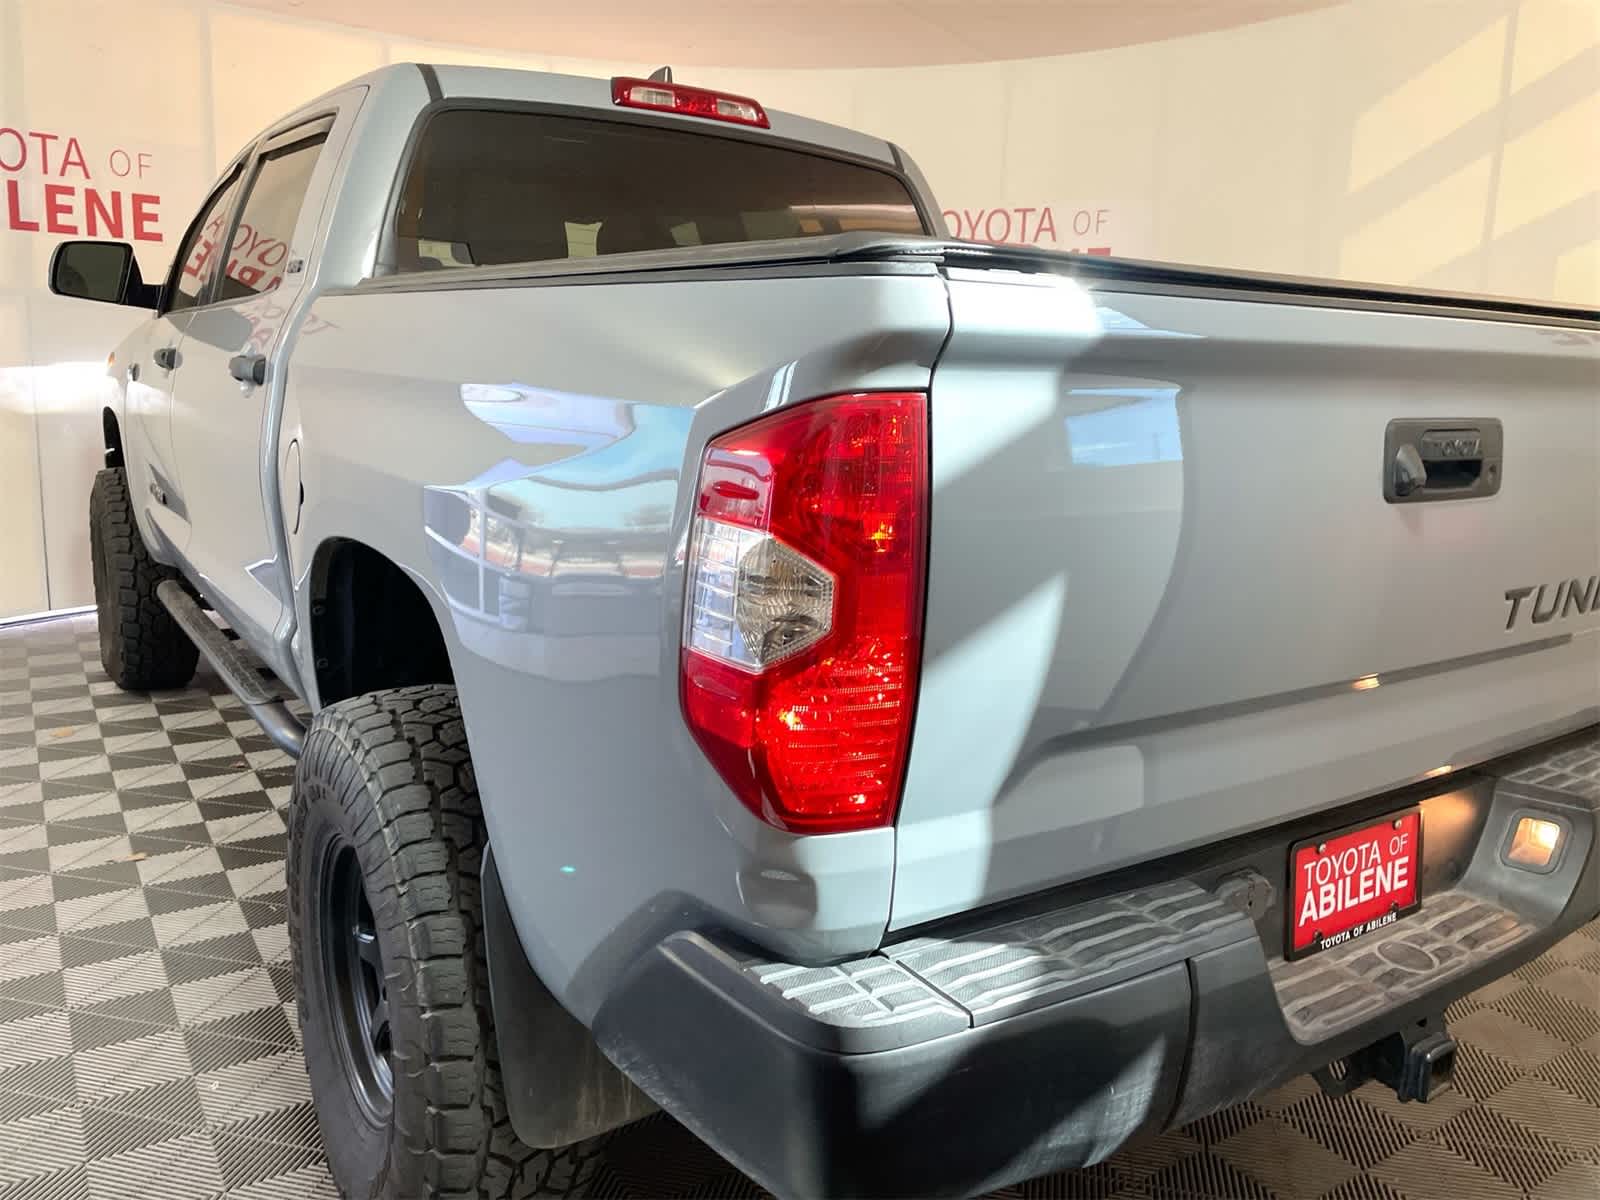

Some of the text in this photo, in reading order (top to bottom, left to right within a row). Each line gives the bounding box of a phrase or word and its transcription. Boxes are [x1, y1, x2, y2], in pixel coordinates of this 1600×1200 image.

[109, 149, 153, 179] OF
[7, 179, 163, 242] LENE
[1072, 208, 1110, 236] OF
[1504, 575, 1600, 630] TUN
[1303, 832, 1409, 890] TOYOTA OF
[1298, 855, 1409, 928] ABILENE
[1320, 911, 1397, 950] TOYOTA OF ABILENE
